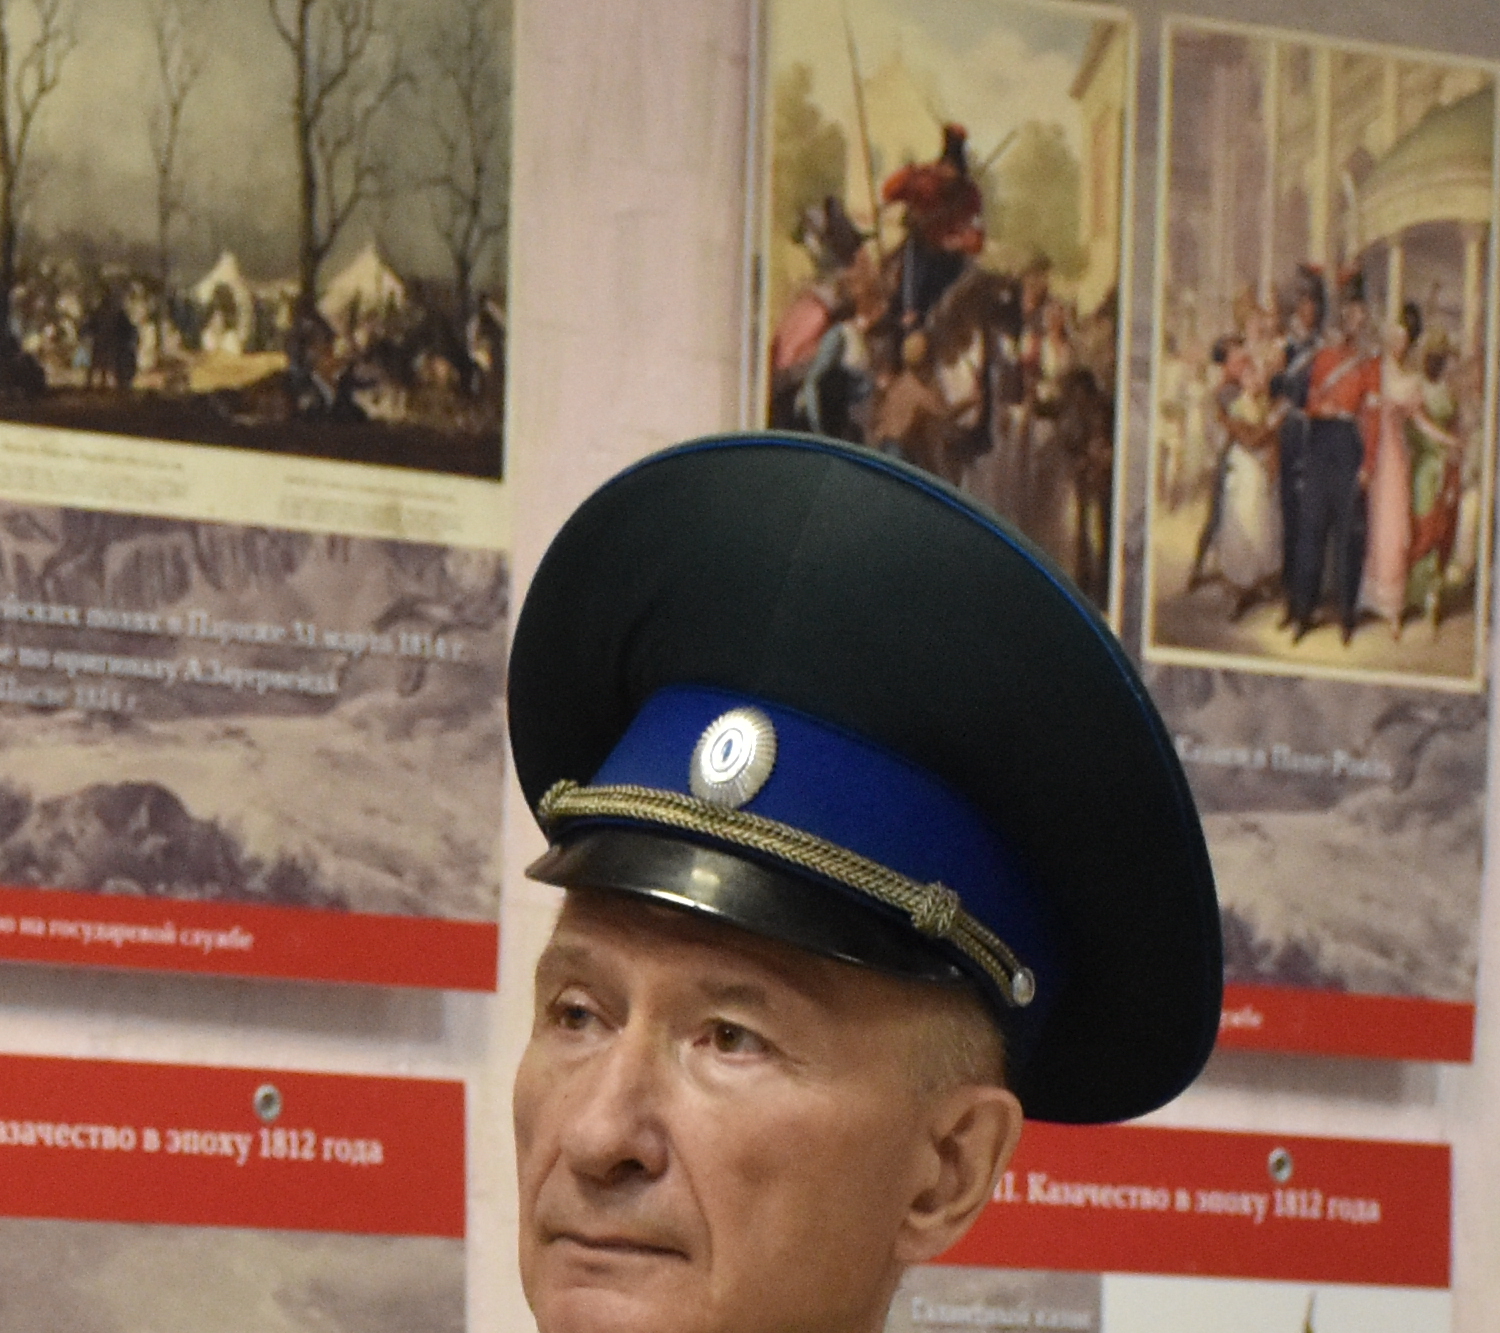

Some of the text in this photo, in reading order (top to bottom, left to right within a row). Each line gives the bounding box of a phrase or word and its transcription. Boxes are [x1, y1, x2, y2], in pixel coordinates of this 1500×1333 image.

[142, 1129, 161, 1154] в
[166, 1129, 252, 1168] эпоху
[259, 1126, 316, 1161] 1812
[322, 1136, 384, 1167] года
[1028, 1171, 1169, 1212] Казачество
